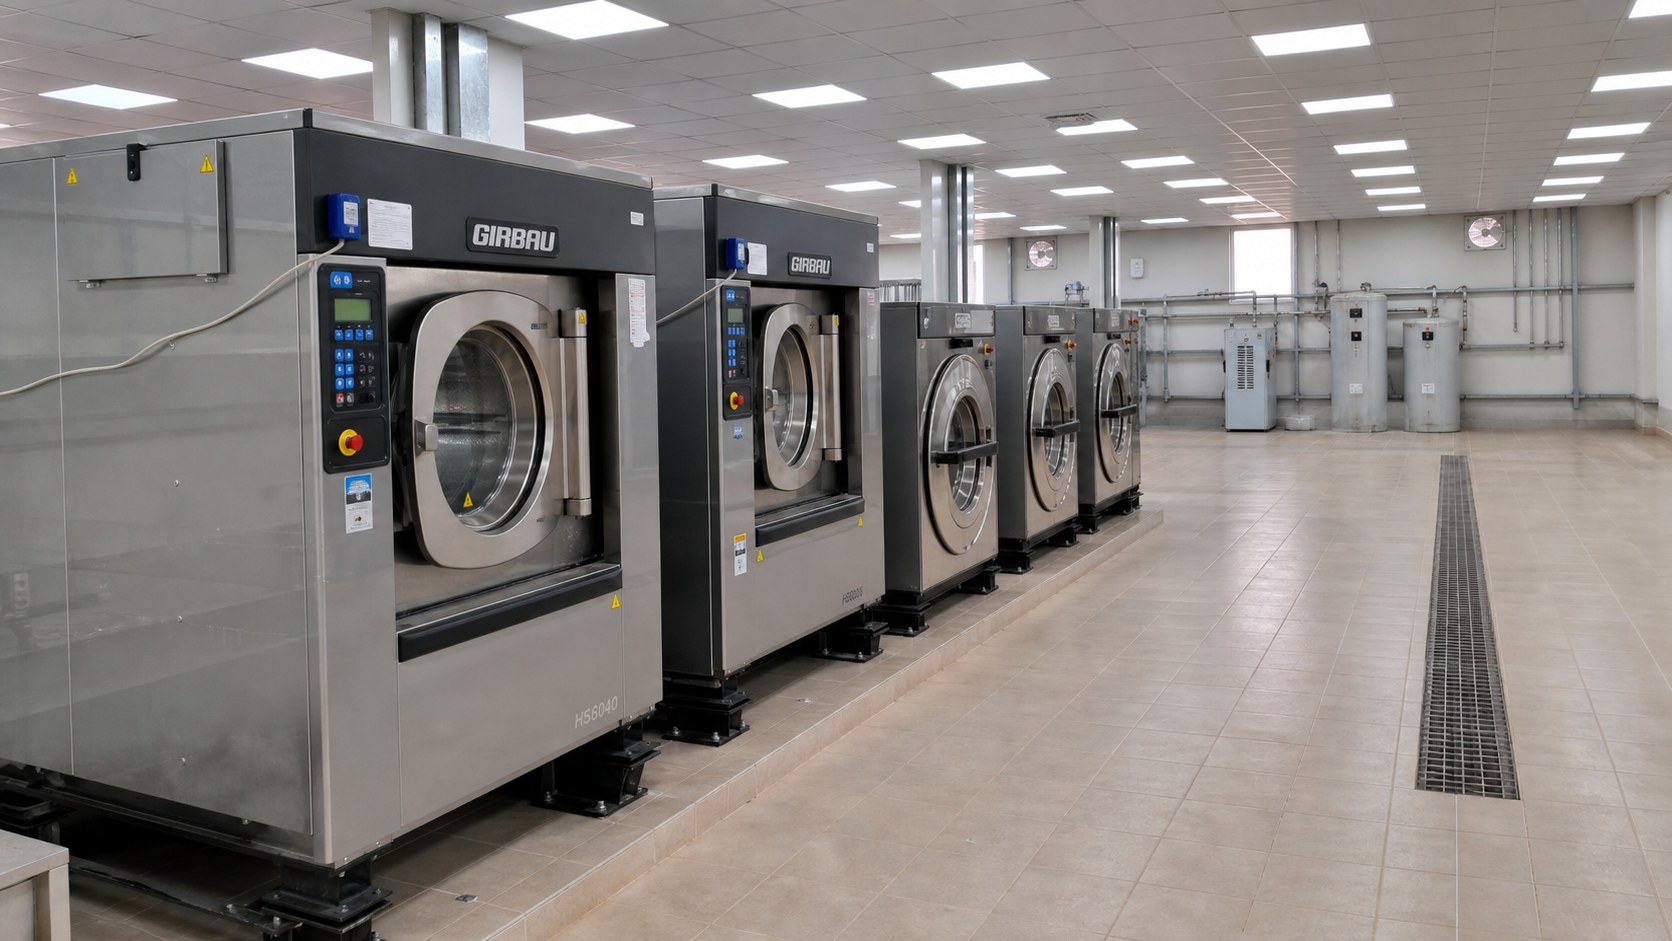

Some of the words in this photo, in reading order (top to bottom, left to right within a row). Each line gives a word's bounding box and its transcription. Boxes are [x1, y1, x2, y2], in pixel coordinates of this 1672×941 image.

[472, 223, 555, 252] GIRBAU
[791, 256, 830, 275] GIRBAU
[574, 695, 618, 729] HS6040
